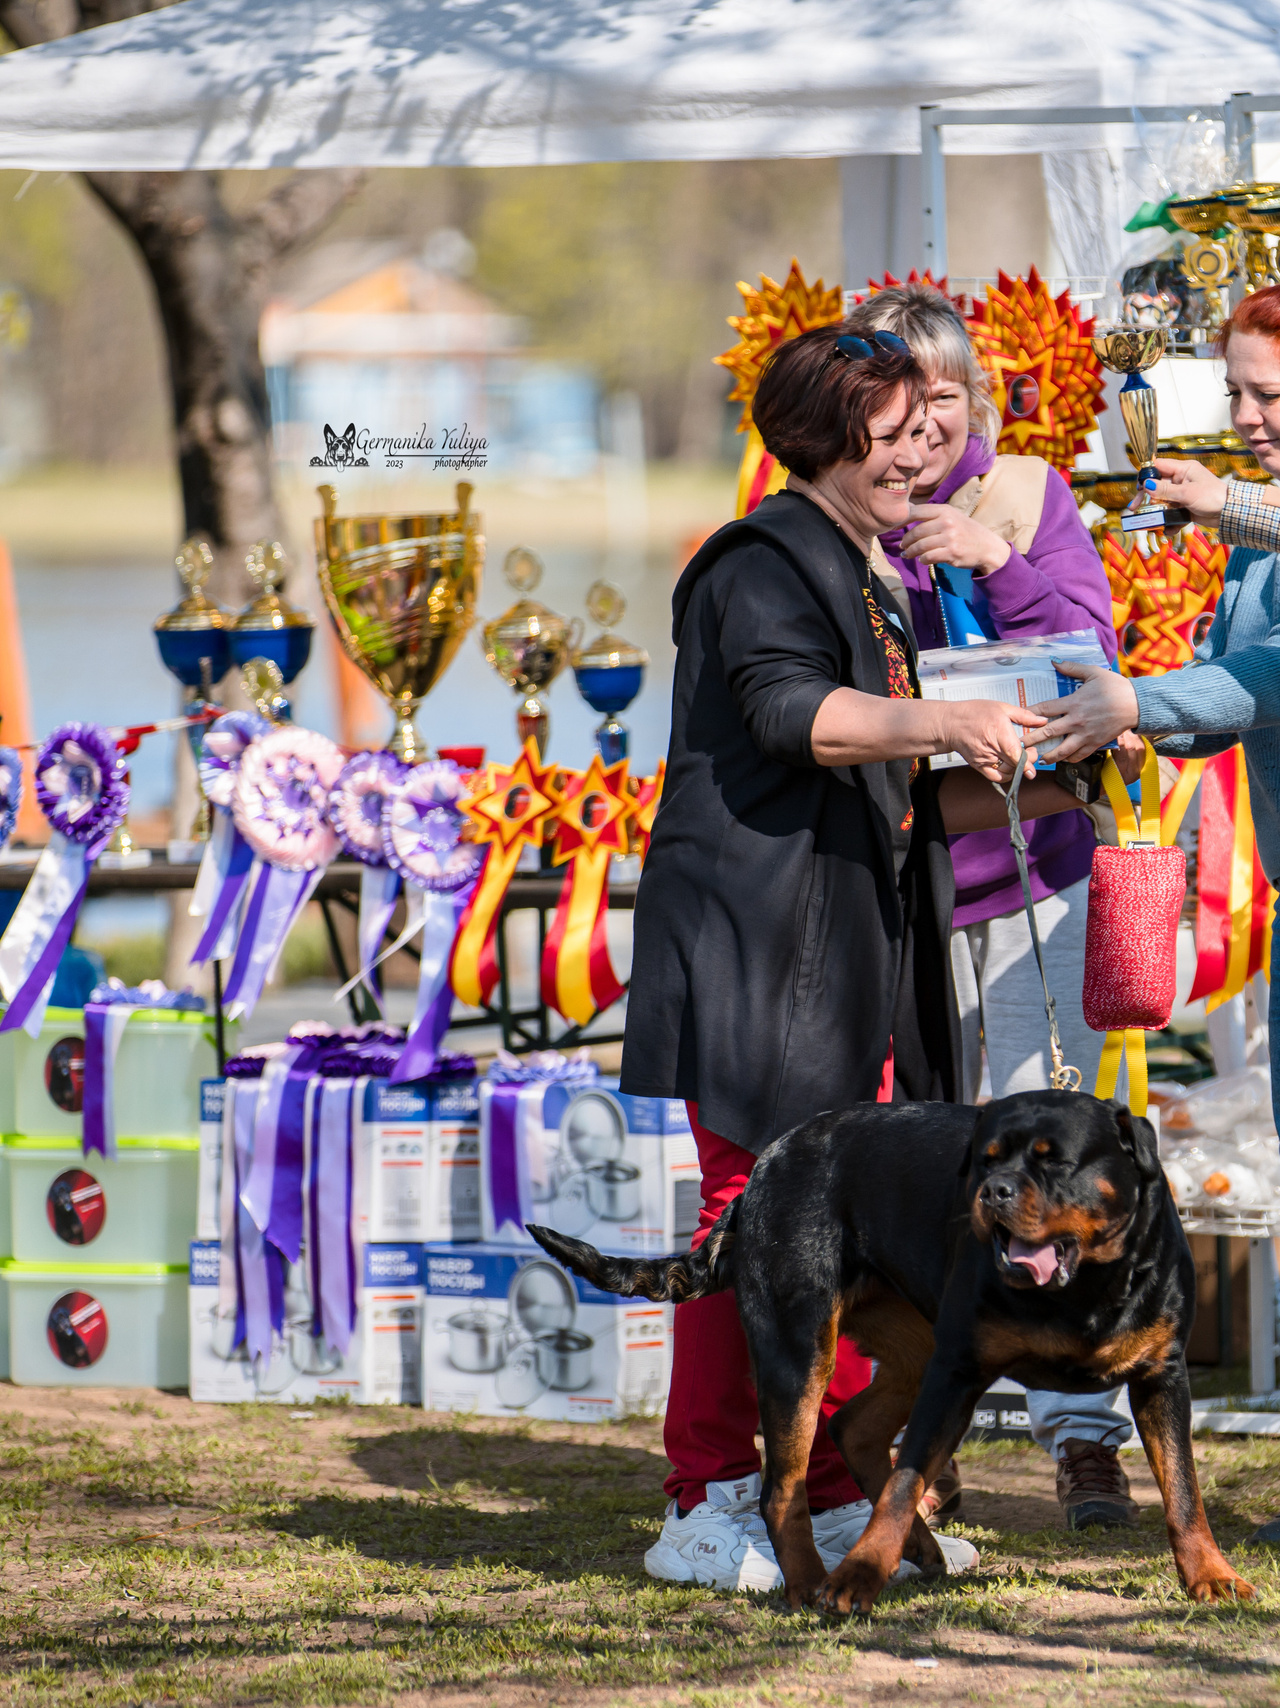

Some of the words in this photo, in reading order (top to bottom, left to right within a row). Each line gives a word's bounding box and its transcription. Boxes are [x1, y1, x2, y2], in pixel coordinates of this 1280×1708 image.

[370, 1264, 418, 1277] ПОСУДЫ
[428, 1258, 474, 1274] НАБОР
[428, 1273, 486, 1291] ПОСУДЫ
[697, 1542, 718, 1554] FILA
